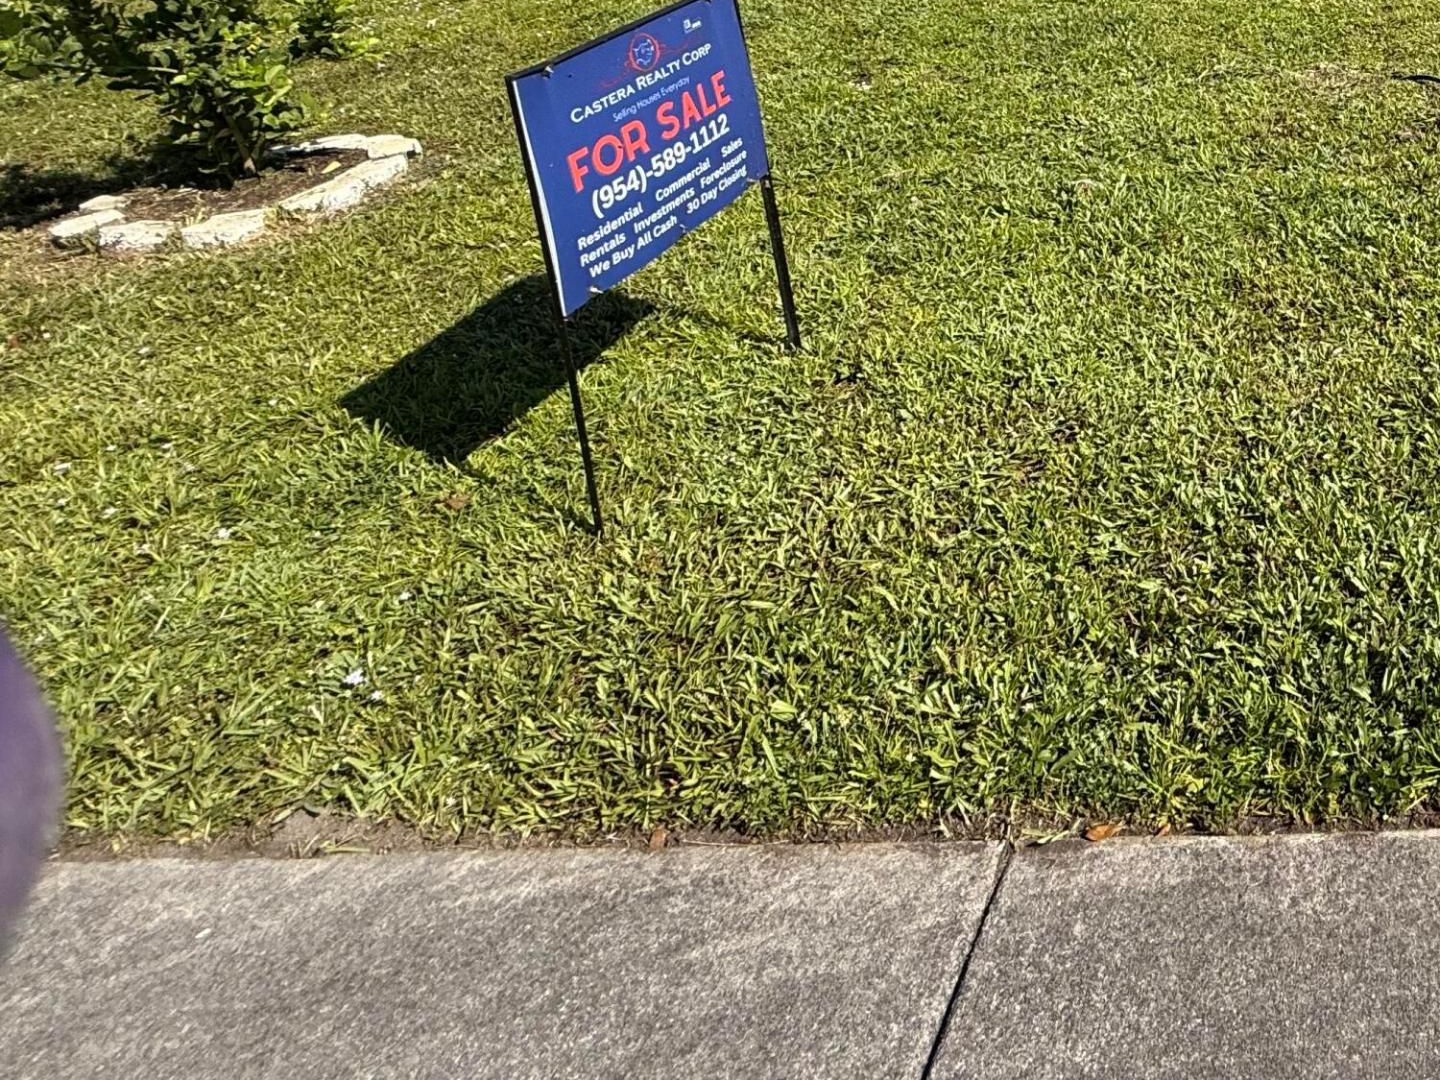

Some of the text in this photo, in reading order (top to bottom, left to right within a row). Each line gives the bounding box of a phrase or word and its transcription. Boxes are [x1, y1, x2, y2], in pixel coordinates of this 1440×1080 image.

[566, 69, 733, 194] FOR SALE
[570, 43, 712, 123] CASTERA REALTY CORP
[612, 76, 690, 122] Selling Houses Everyday
[577, 137, 744, 251] Residential Commercial Sales
[580, 150, 748, 267] Rentals Investments Foreclosure
[588, 164, 748, 278] We Buy All Cash 30 Day Closing
[591, 113, 731, 219] (954)-589-1112
